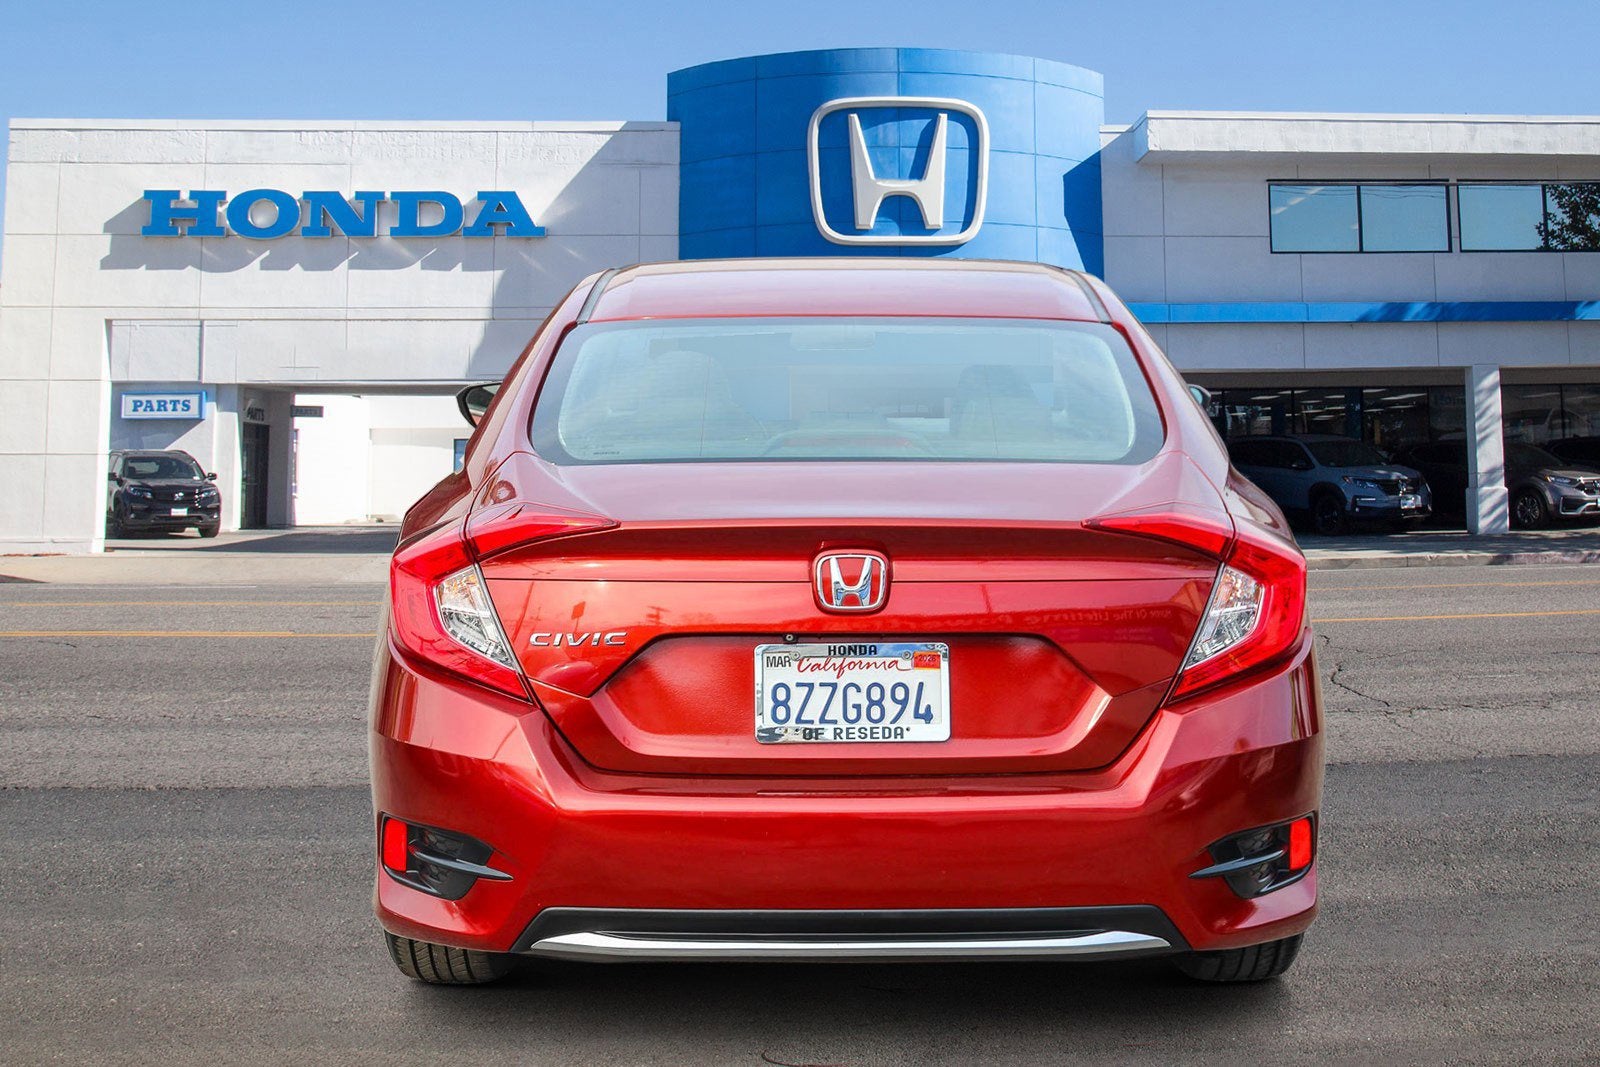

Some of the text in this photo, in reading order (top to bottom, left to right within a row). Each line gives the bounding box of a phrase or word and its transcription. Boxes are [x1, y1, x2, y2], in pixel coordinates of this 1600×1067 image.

[141, 188, 547, 239] HONDA
[132, 399, 191, 413] PARTS
[529, 631, 628, 646] CIVIC
[827, 644, 878, 656] HONDA
[766, 655, 914, 679] MAR California
[770, 681, 934, 725] 8ZZG894
[802, 726, 905, 741] OF RESEDA
